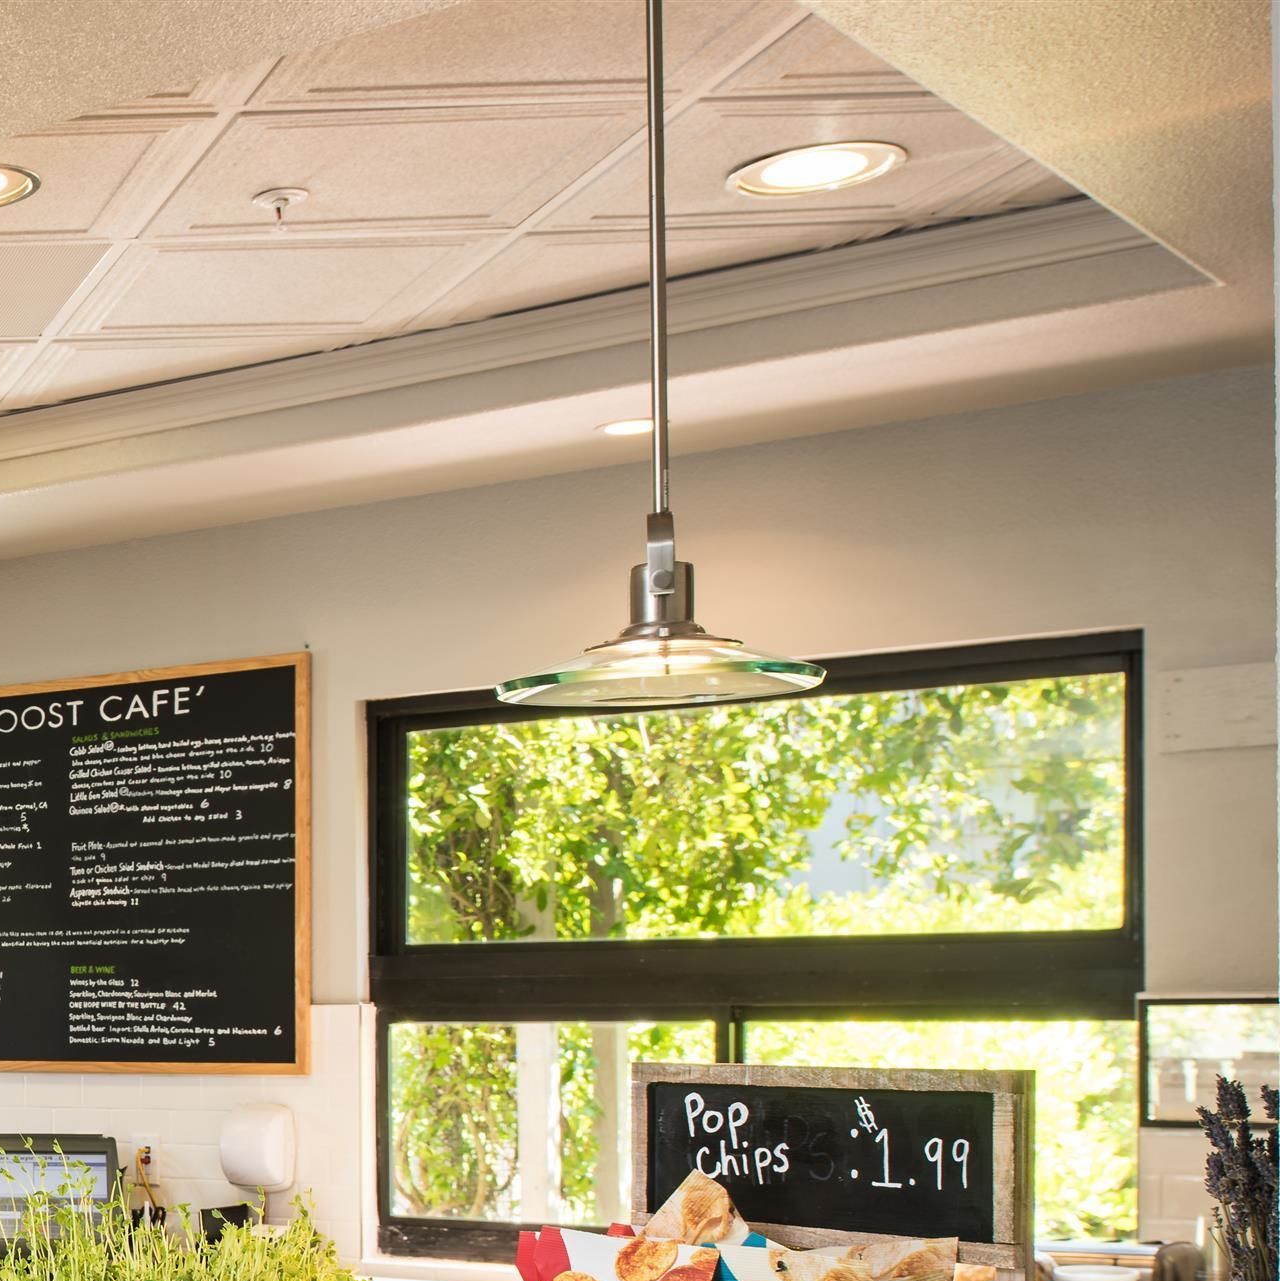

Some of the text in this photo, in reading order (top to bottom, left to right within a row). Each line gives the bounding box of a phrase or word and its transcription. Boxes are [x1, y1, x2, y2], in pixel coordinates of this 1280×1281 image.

[69, 743, 104, 756] Cobb Salad
[261, 743, 274, 752] 10
[69, 763, 152, 779] Grilled Chicken Salad
[220, 769, 232, 779] 10
[283, 779, 292, 790] 8
[200, 799, 209, 809] 6
[21, 812, 27, 821] 5
[235, 810, 242, 820] 3
[100, 852, 106, 861] 9
[94, 861, 135, 874] Chicken Salad
[70, 966, 87, 974] BEER
[89, 979, 96, 987] by
[130, 978, 139, 987] 12
[133, 990, 164, 998] Sauvignon
[164, 990, 181, 998] Blanc
[183, 990, 194, 998] and
[69, 1001, 82, 1009] ONE
[83, 1001, 99, 1009] HOPE
[140, 1002, 166, 1010] BOTTLE
[172, 1002, 186, 1011] 42
[96, 1013, 125, 1022] Sauvignon
[126, 1013, 142, 1021] Blanc
[156, 1014, 192, 1023] Chardonnay
[69, 1024, 90, 1032] Bottled
[217, 1027, 230, 1035] and
[273, 1026, 283, 1036] 6
[163, 1037, 176, 1045] Bud
[178, 1038, 200, 1048] Light
[208, 1037, 216, 1047] 5
[684, 1092, 749, 1149] Pop
